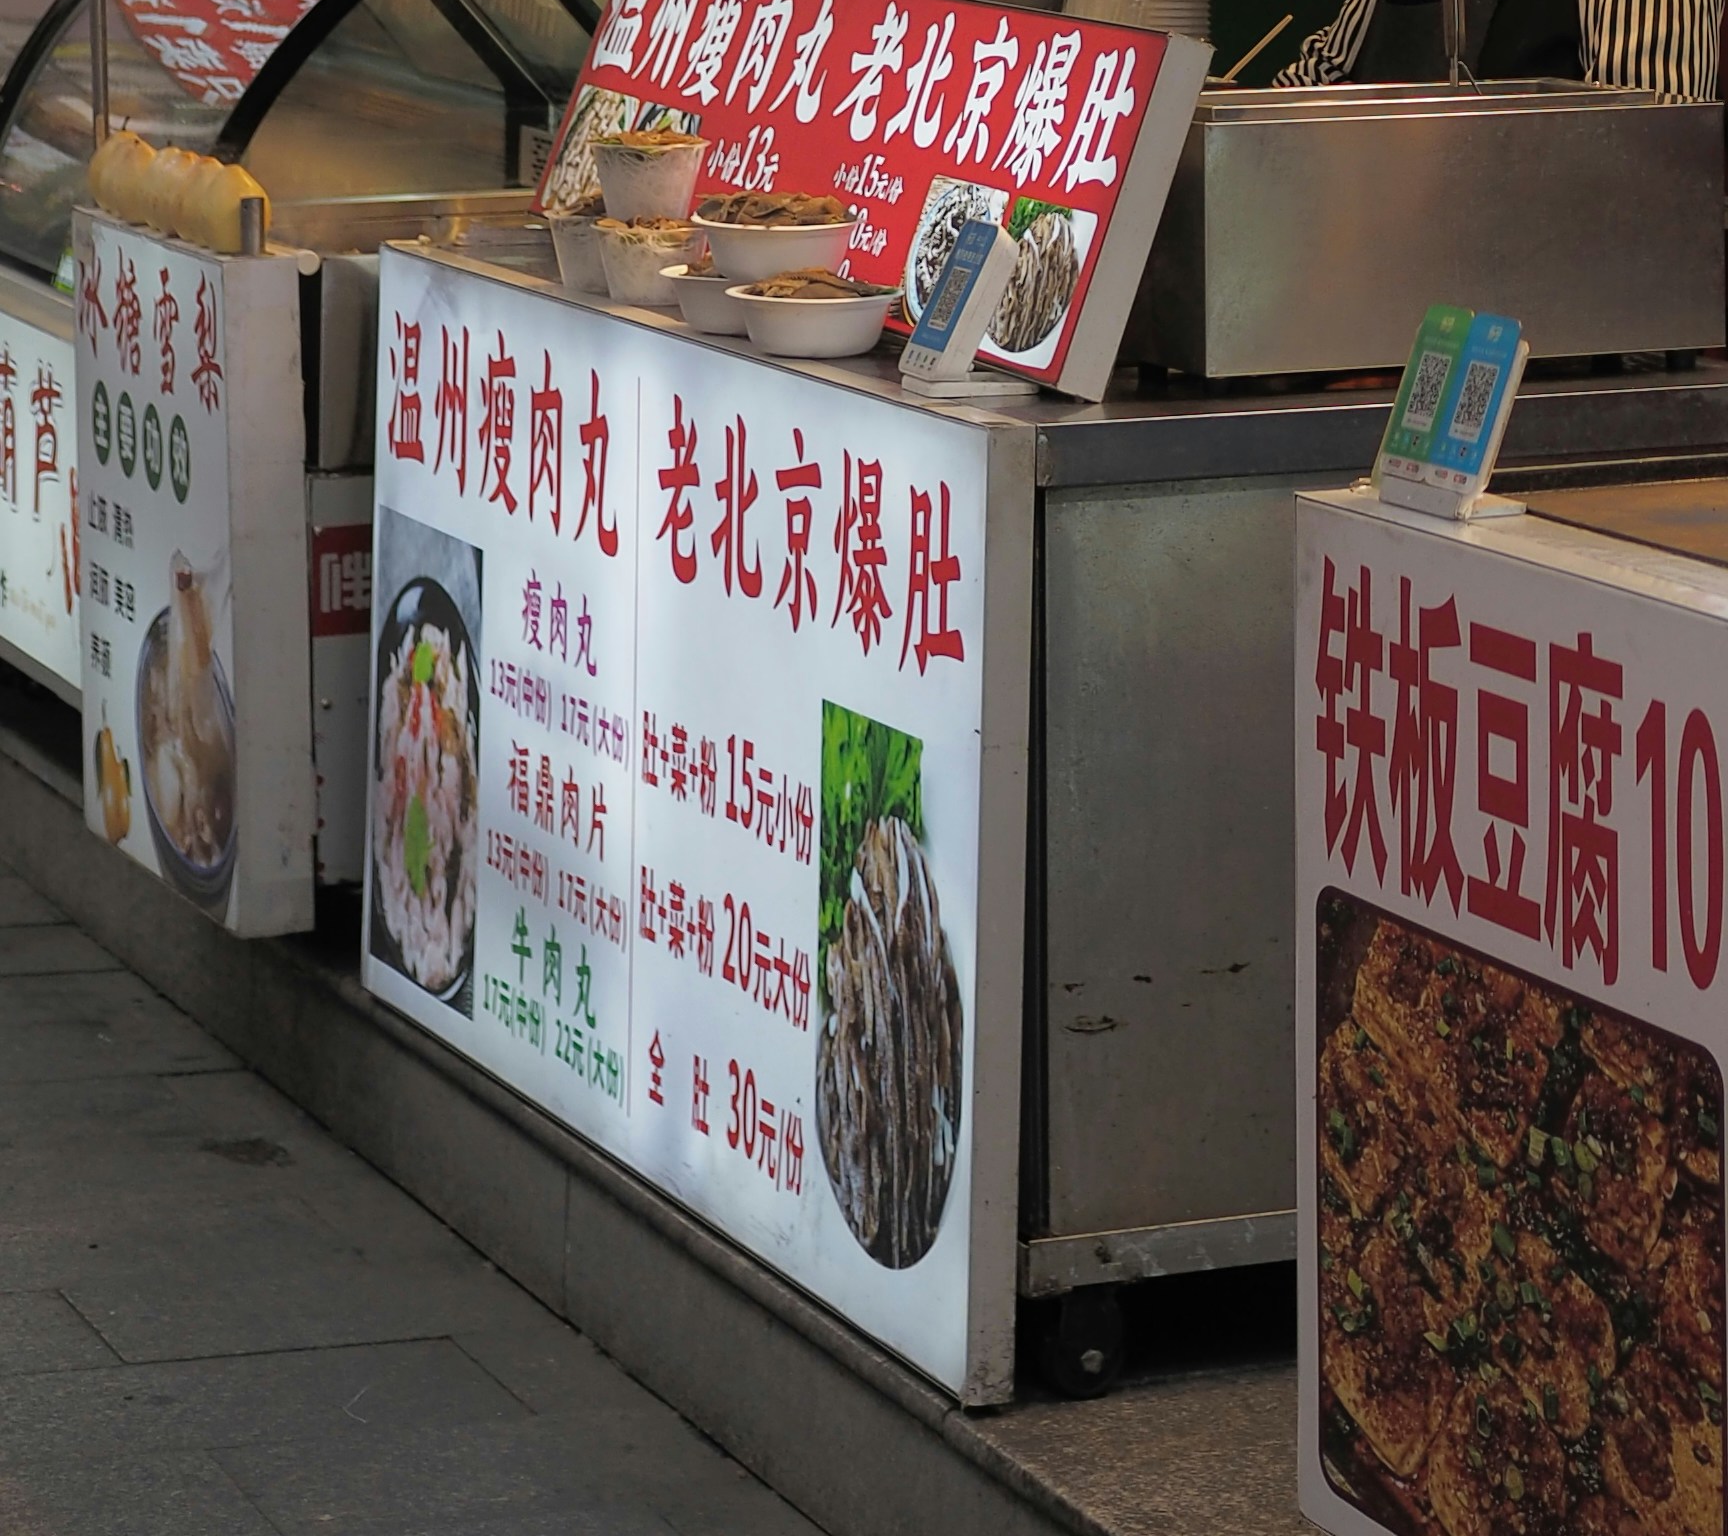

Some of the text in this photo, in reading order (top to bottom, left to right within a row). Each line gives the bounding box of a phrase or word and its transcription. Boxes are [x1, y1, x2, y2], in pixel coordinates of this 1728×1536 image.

[706, 123, 782, 194] 小份13元
[832, 0, 1139, 194] 老北京爆肚
[833, 152, 905, 206] 小份15元/份
[77, 239, 224, 416] 冰糖雪梨
[387, 309, 620, 558] 温州瘦肉丸
[654, 393, 966, 678] 老北京爆肚
[520, 567, 598, 678] 瘦肉丸
[560, 692, 631, 773] 17元(大份)
[506, 738, 609, 863] 福鼎肉片
[724, 733, 815, 866] 15元小份
[509, 905, 597, 1030] 牛肉丸
[557, 869, 628, 954] 17元(大份)
[721, 892, 812, 1033] 20元大份
[553, 1019, 626, 1110] 22元(大份)
[727, 1057, 806, 1197] 30元/份
